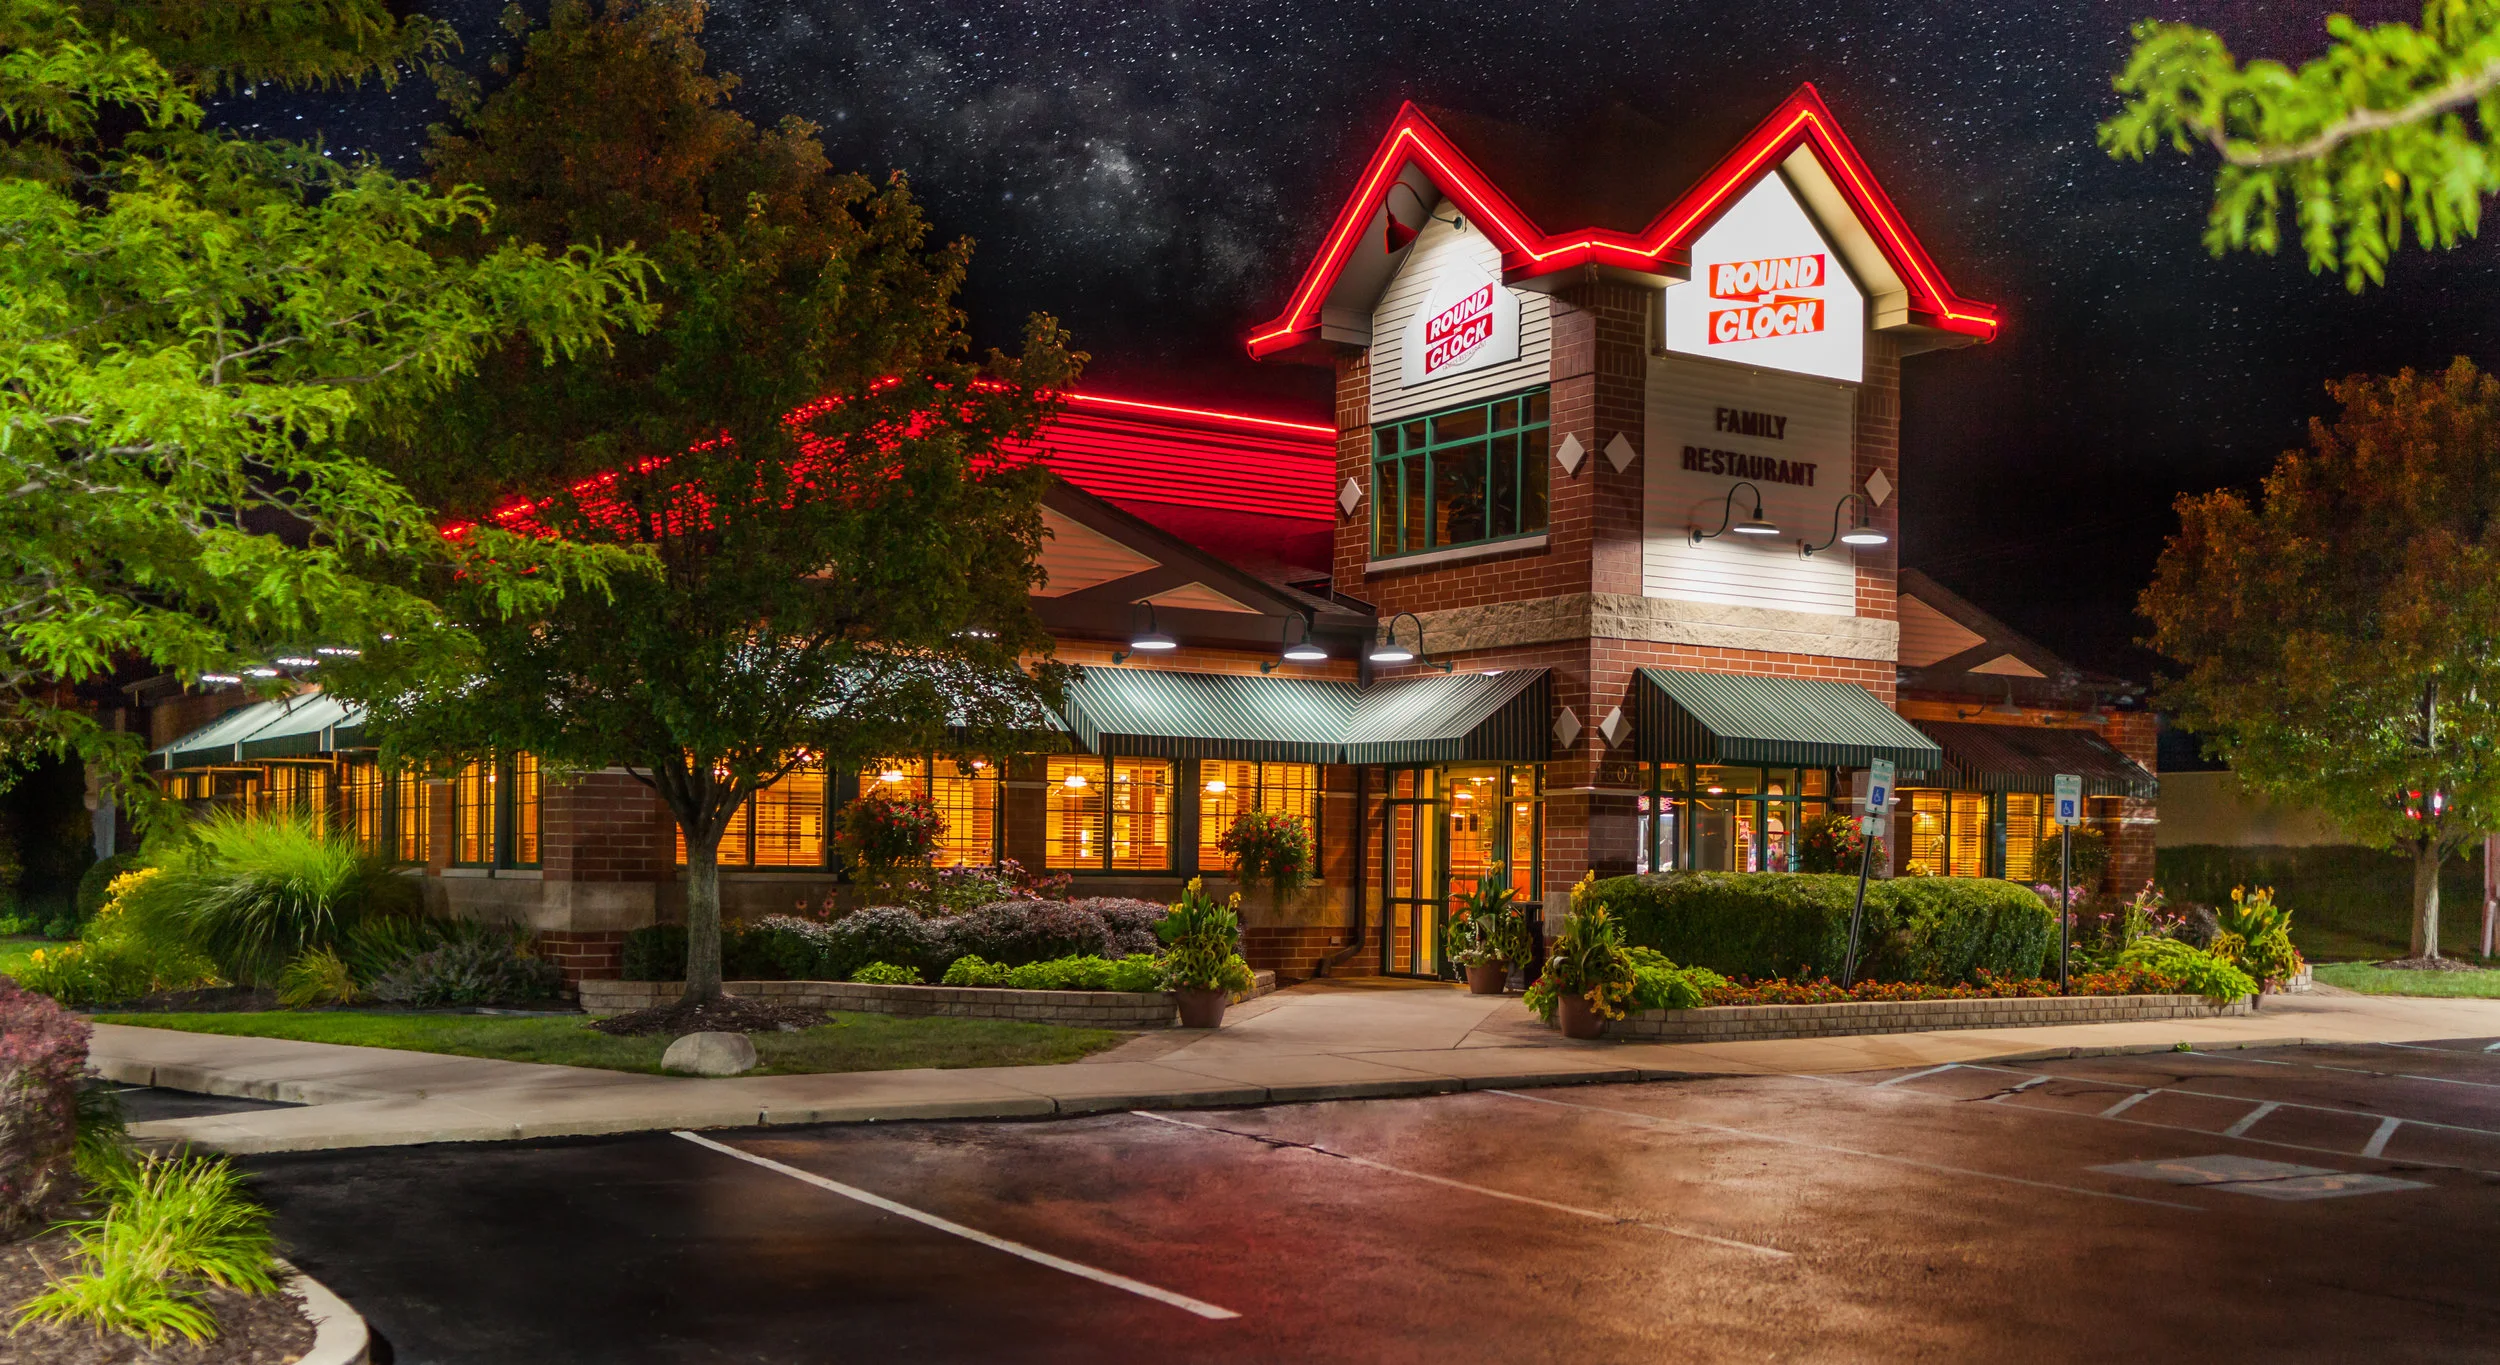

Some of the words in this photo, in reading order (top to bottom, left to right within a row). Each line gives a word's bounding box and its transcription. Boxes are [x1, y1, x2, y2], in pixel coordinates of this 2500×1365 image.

[1714, 256, 1819, 296] ROUND
[1430, 288, 1489, 340] ROUND
[1715, 302, 1817, 342] CLOCK
[1430, 318, 1488, 369] CLOCK
[1715, 407, 1788, 440] FAMILY
[1682, 445, 1818, 488] RESTAURANT
